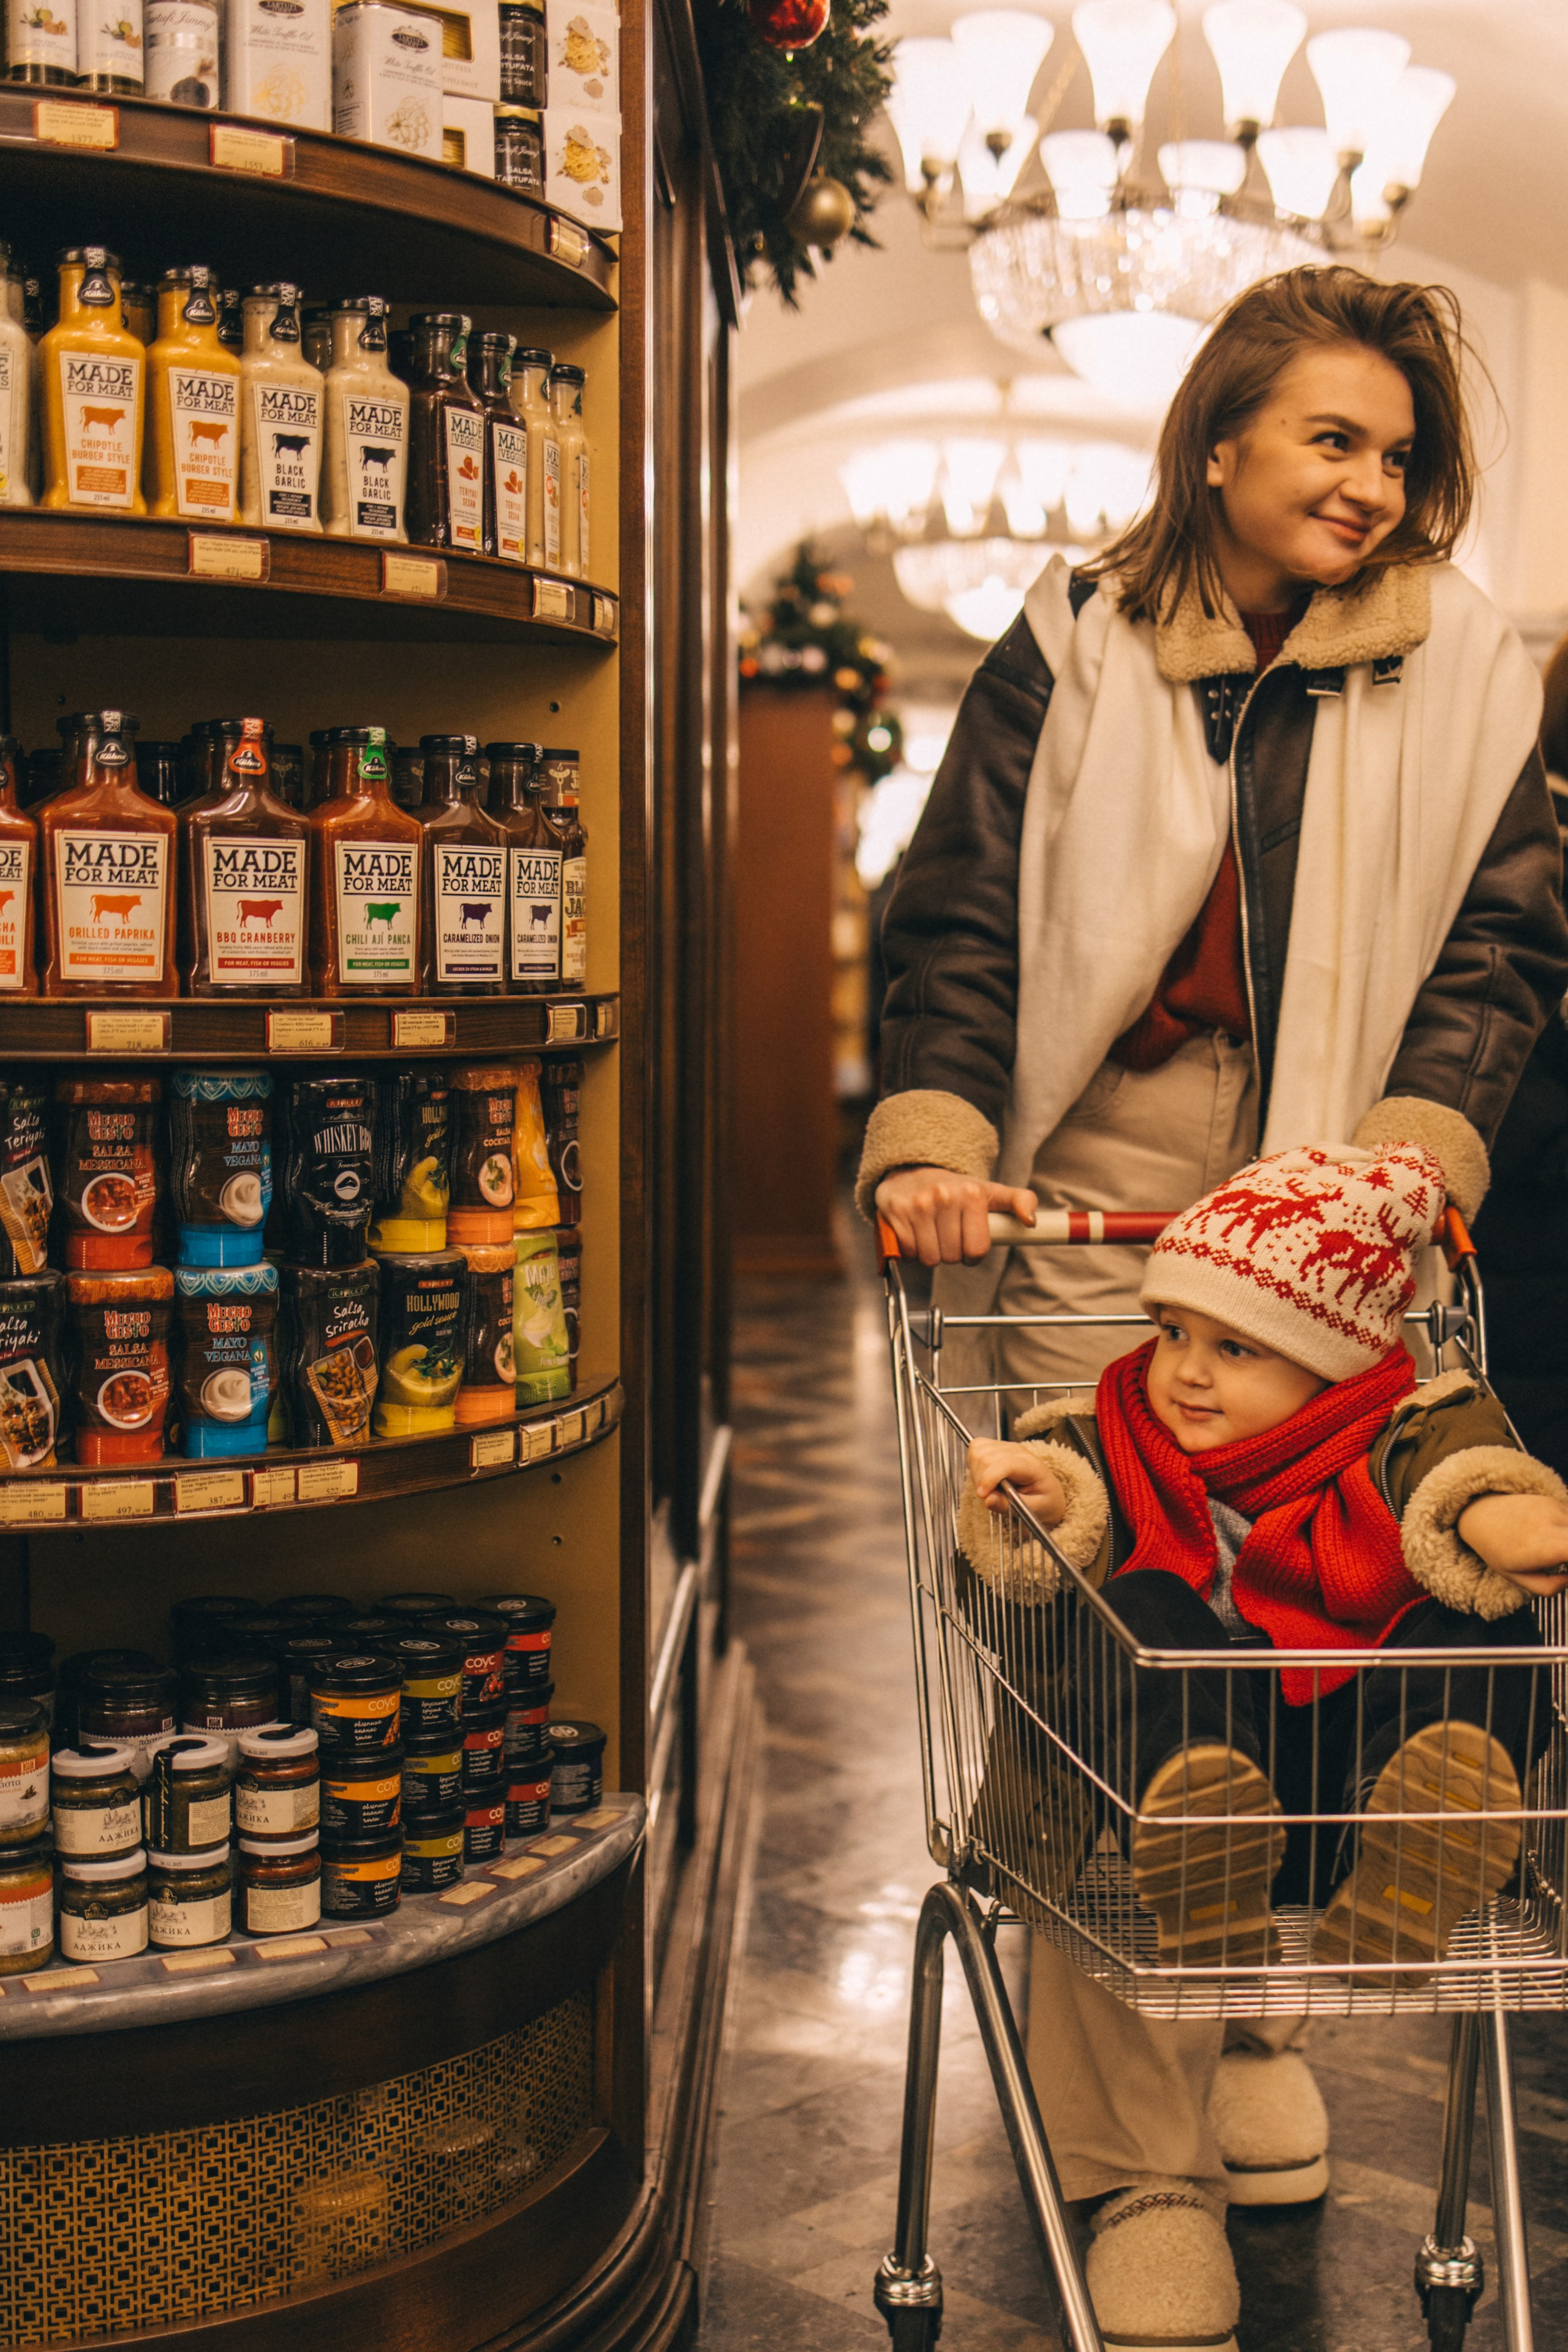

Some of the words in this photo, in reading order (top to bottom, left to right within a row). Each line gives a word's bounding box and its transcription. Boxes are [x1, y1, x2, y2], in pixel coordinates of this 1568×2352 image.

[250, 24, 271, 36] White
[272, 27, 298, 41] Truffle
[299, 31, 315, 41] Oil
[385, 56, 402, 67] White
[404, 59, 424, 73] Truffle
[425, 66, 437, 75] Oil
[507, 166, 532, 176] SALSA
[495, 174, 540, 187] TARTUFATA
[68, 363, 132, 386] MADE
[68, 380, 96, 393] FOR
[97, 383, 134, 398] MEAT
[176, 378, 234, 402] MADE
[177, 396, 202, 409] FOR
[204, 399, 235, 413] MEAT
[260, 390, 316, 414] MADE
[261, 408, 285, 421] FOR
[287, 412, 317, 425] MEAT
[350, 404, 402, 427] MADE
[350, 421, 372, 434] FOR
[374, 424, 402, 438] MEAT
[451, 416, 483, 439] MADE
[81, 439, 123, 453] CHIPOTLE
[454, 432, 483, 450] VEGGIES
[498, 432, 526, 454] MADE
[72, 449, 104, 462] BURGER
[107, 452, 130, 464] STYLE
[189, 453, 226, 466] CHIPOTLE
[181, 463, 210, 475] BURGER
[213, 466, 233, 478] STYLE
[276, 464, 304, 477] BLACK
[275, 475, 306, 489] GARLIC
[364, 475, 389, 489] BLACK
[363, 488, 391, 500] GARLIC
[99, 752, 126, 761] Kühne
[65, 842, 157, 869] MADE
[213, 848, 297, 874] MADE
[344, 853, 412, 876] MADE
[442, 855, 502, 878] MADE
[517, 859, 559, 881] MADE
[65, 867, 103, 882] FOR
[108, 869, 159, 884] MEAT
[213, 873, 248, 887] FOR
[252, 875, 298, 889] MEAT
[344, 877, 374, 891] FOR
[377, 878, 413, 892] MEAT
[442, 878, 469, 892] FOR
[471, 879, 502, 892] MEAT
[517, 881, 537, 894] FOR
[538, 882, 559, 895] MEAT
[69, 927, 110, 939] GRILLED
[115, 928, 155, 940] PAPRIKA
[217, 932, 236, 943] BBQ
[240, 932, 295, 943] CRANBERRY
[345, 934, 368, 944] CHILI
[372, 932, 384, 944] AJÍ
[388, 934, 411, 944] PANCA
[443, 933, 483, 944] CARAMELIZED
[485, 933, 500, 944] ONION
[517, 933, 546, 944] CARAMELIZED
[13, 1112, 40, 1131] Salsa
[87, 1110, 135, 1126] MUCHO
[227, 1107, 264, 1123] MUCHO
[89, 1125, 134, 1140] GUSTO
[228, 1121, 263, 1137] GUSTO
[4, 1128, 46, 1151] Teriyaki
[314, 1123, 357, 1154] WHISKEY
[359, 1127, 372, 1154] BBQ
[92, 1145, 134, 1157] SALSA
[231, 1140, 259, 1153] MAYO
[78, 1158, 146, 1171] MESSICANA
[223, 1154, 262, 1167] VEGANA
[135, 1172, 152, 1181] GLUTEN
[407, 1292, 460, 1312] HOLLYWOOD
[207, 1303, 252, 1319] MUCHO
[333, 1301, 363, 1319] Salsa
[0, 1316, 28, 1331] alsa
[104, 1310, 151, 1327] MUCHO
[208, 1317, 251, 1333] GUSTO
[325, 1312, 369, 1338] sriracha
[409, 1315, 434, 1335] gold
[434, 1310, 458, 1325] sauce
[106, 1324, 149, 1340] GUSTO
[109, 1342, 149, 1356] SALSA
[213, 1336, 247, 1349] MAYO
[94, 1355, 161, 1370] MESSICANA
[204, 1350, 252, 1363] VEGANA
[251, 1364, 266, 1373] GLUTEN
[250, 1378, 270, 1387] PRODOTTO
[0, 1779, 21, 1789] άστα
[99, 1826, 139, 1843] АДЖИКА
[149, 1923, 191, 1936] АДЖИКА
[74, 1942, 121, 1951] АДЖИКА
